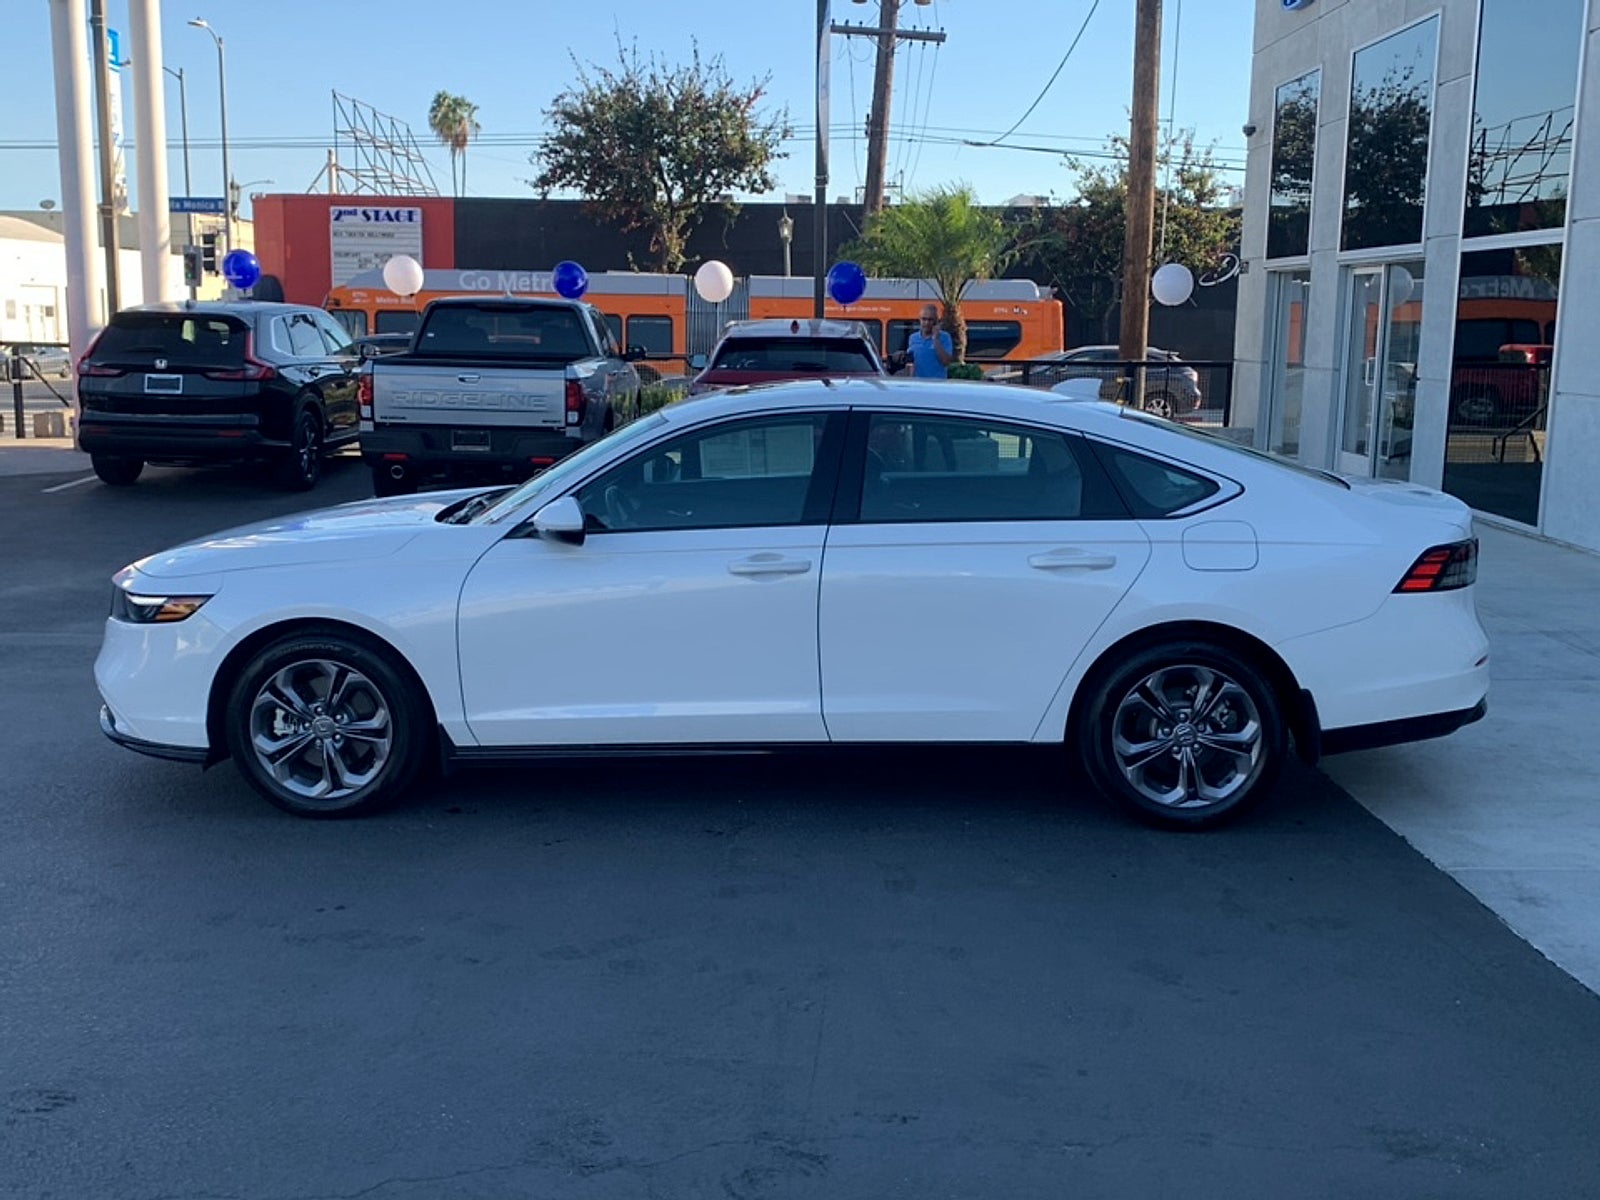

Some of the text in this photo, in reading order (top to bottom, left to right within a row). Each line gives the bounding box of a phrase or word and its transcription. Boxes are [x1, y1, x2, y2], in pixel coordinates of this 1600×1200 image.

[333, 208, 417, 223] 2nd STAGE
[458, 271, 554, 292] Go Metr
[391, 390, 549, 409] RIDGELINE
